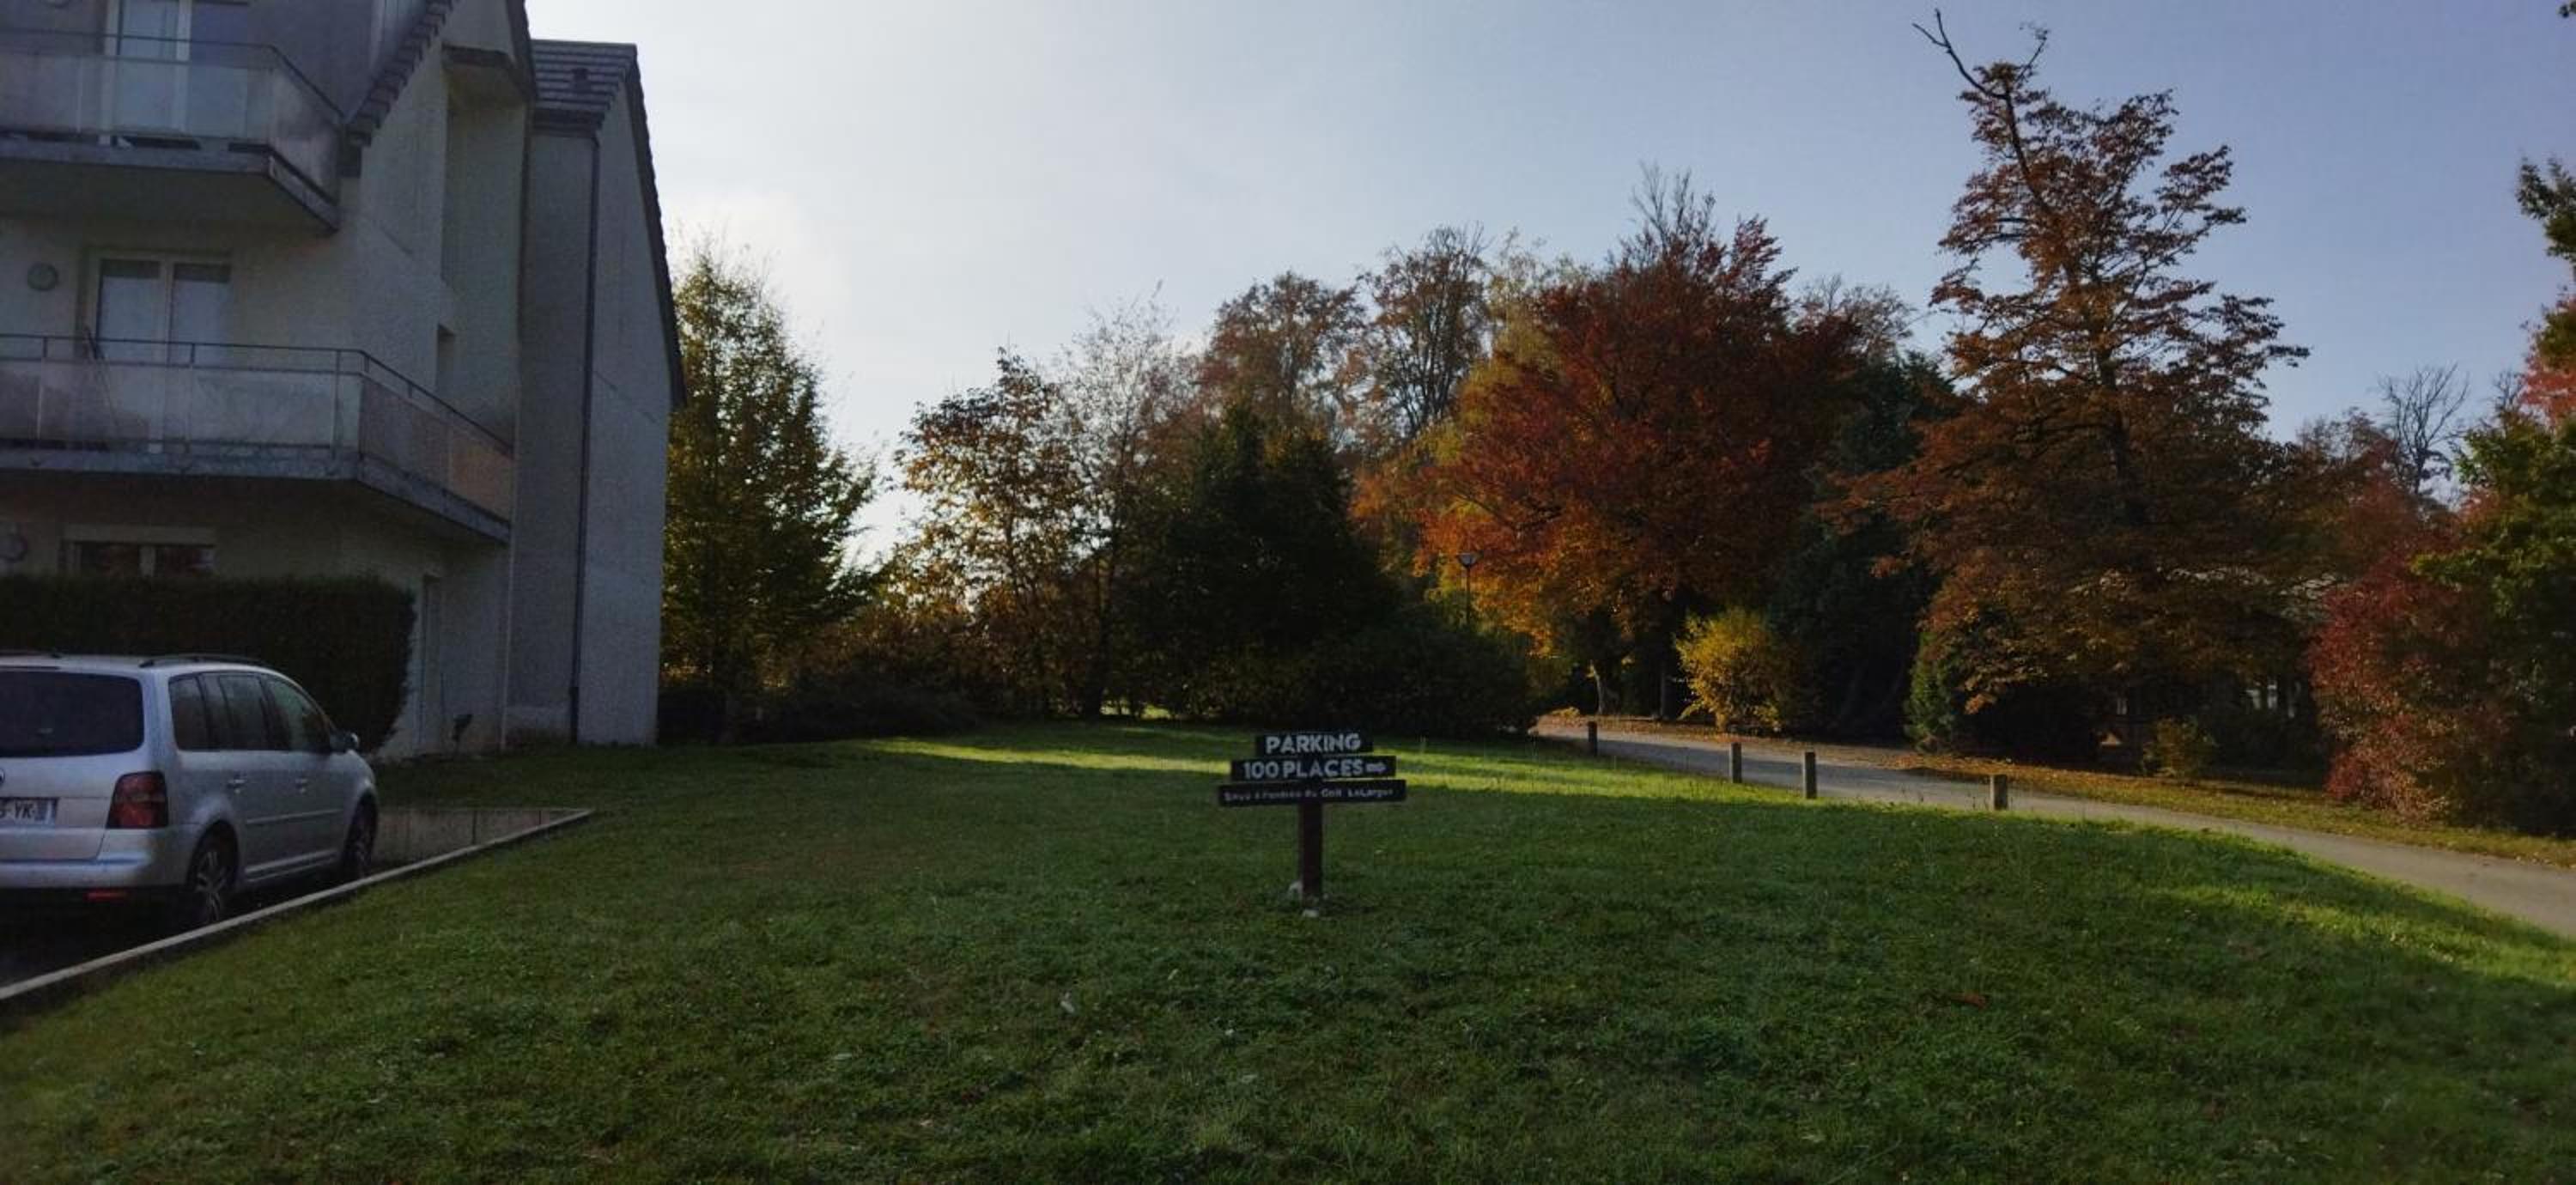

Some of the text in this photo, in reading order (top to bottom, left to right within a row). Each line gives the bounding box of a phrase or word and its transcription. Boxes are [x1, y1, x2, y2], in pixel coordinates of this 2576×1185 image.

[1265, 732, 1362, 754] PARKING
[1244, 759, 1364, 779] 100 PLACES
